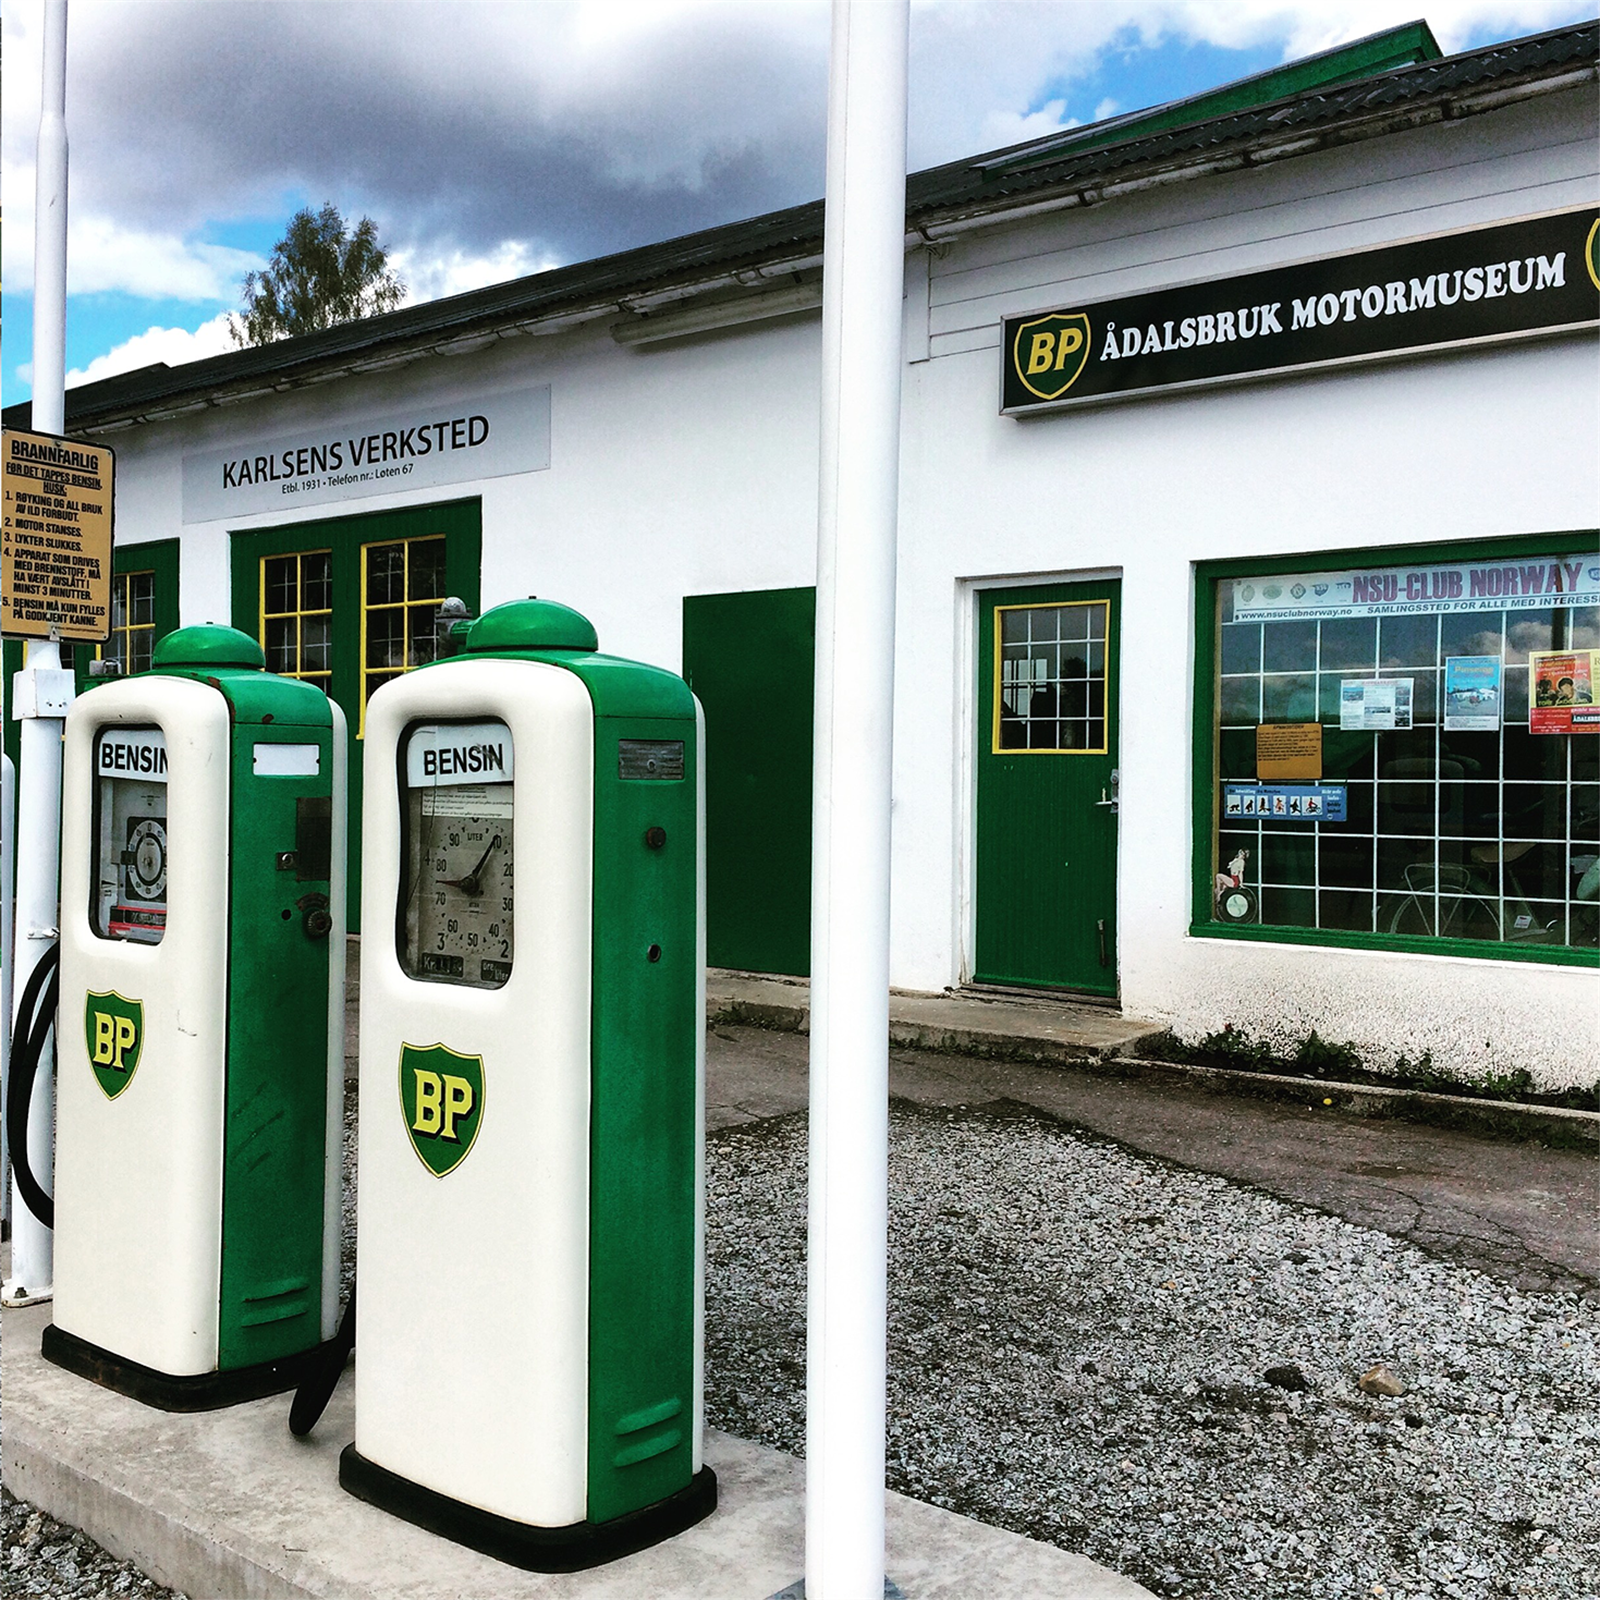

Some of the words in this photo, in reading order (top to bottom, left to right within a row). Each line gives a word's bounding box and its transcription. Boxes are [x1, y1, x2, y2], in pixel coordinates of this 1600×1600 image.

[1099, 302, 1283, 361] ÅDALSBRUK
[1291, 252, 1567, 331] MOTORMUSEUM
[1025, 327, 1083, 375] BP
[11, 439, 98, 470] BRANNFARLIG
[222, 441, 343, 489] KARLSENS
[348, 415, 490, 467] VERKSTED
[6, 462, 22, 474] FØR
[24, 465, 39, 477] DET
[40, 468, 70, 483] TAPPES
[281, 483, 300, 494] Etbl.
[302, 479, 321, 491] 1931
[327, 473, 359, 487] Telefon
[375, 467, 400, 479] Løten
[402, 463, 414, 474] 67
[5, 490, 13, 500] 1.
[16, 491, 52, 507] RØYKING
[54, 498, 64, 509] OG
[66, 500, 80, 511] ALL
[81, 502, 103, 515] BRUK
[16, 503, 26, 514] AV
[27, 505, 40, 516] ILD
[41, 507, 80, 522] FORBUDT.
[4, 517, 13, 527] 2.
[15, 518, 44, 532] MOTOR
[45, 523, 83, 538] STANSES.
[4, 532, 12, 543] 3.
[15, 533, 44, 547] LYKTER
[45, 538, 83, 552] SLUKKES.
[3, 547, 12, 557] 4.
[14, 548, 51, 563] APPARAT
[52, 553, 70, 565] SOM
[72, 556, 100, 568] DRIVES
[13, 571, 26, 582] HA
[27, 572, 50, 585] VÆRT
[52, 574, 85, 589] AVSLÅTT
[14, 560, 32, 571] MED
[88, 567, 101, 580] MÅ
[13, 582, 41, 595] MINST
[42, 586, 48, 596] 3
[49, 587, 93, 600] MINUTTER.
[1352, 570, 1463, 604] NSU-CLUB
[1469, 562, 1584, 598] NORWAY
[2, 596, 11, 607] 5.
[13, 598, 44, 610] BENSIN
[46, 600, 60, 612] MÅ
[61, 602, 78, 613] KUN
[80, 605, 106, 616] FYLLES
[1241, 608, 1353, 619] www.nsuclubnorway.no
[1367, 602, 1450, 614] SAMLINGSSTED
[1454, 601, 1476, 610] FOR
[1479, 600, 1507, 609] ALLE
[1511, 598, 1536, 607] MED
[1539, 595, 1600, 606] INTERESS
[13, 608, 24, 619] PÅ
[25, 610, 68, 624] GODKJENT
[69, 615, 98, 627] KANNE.
[423, 743, 503, 776] BENSIN
[449, 832, 460, 847] 90
[436, 858, 447, 872] 80
[435, 892, 446, 906] 70
[502, 897, 513, 911] 30
[447, 919, 458, 933] 60
[488, 923, 499, 938] 40
[437, 932, 445, 951] 3
[467, 933, 478, 947] 50
[500, 939, 509, 958] 2
[93, 1010, 136, 1070] BP
[412, 1068, 474, 1140] BP
